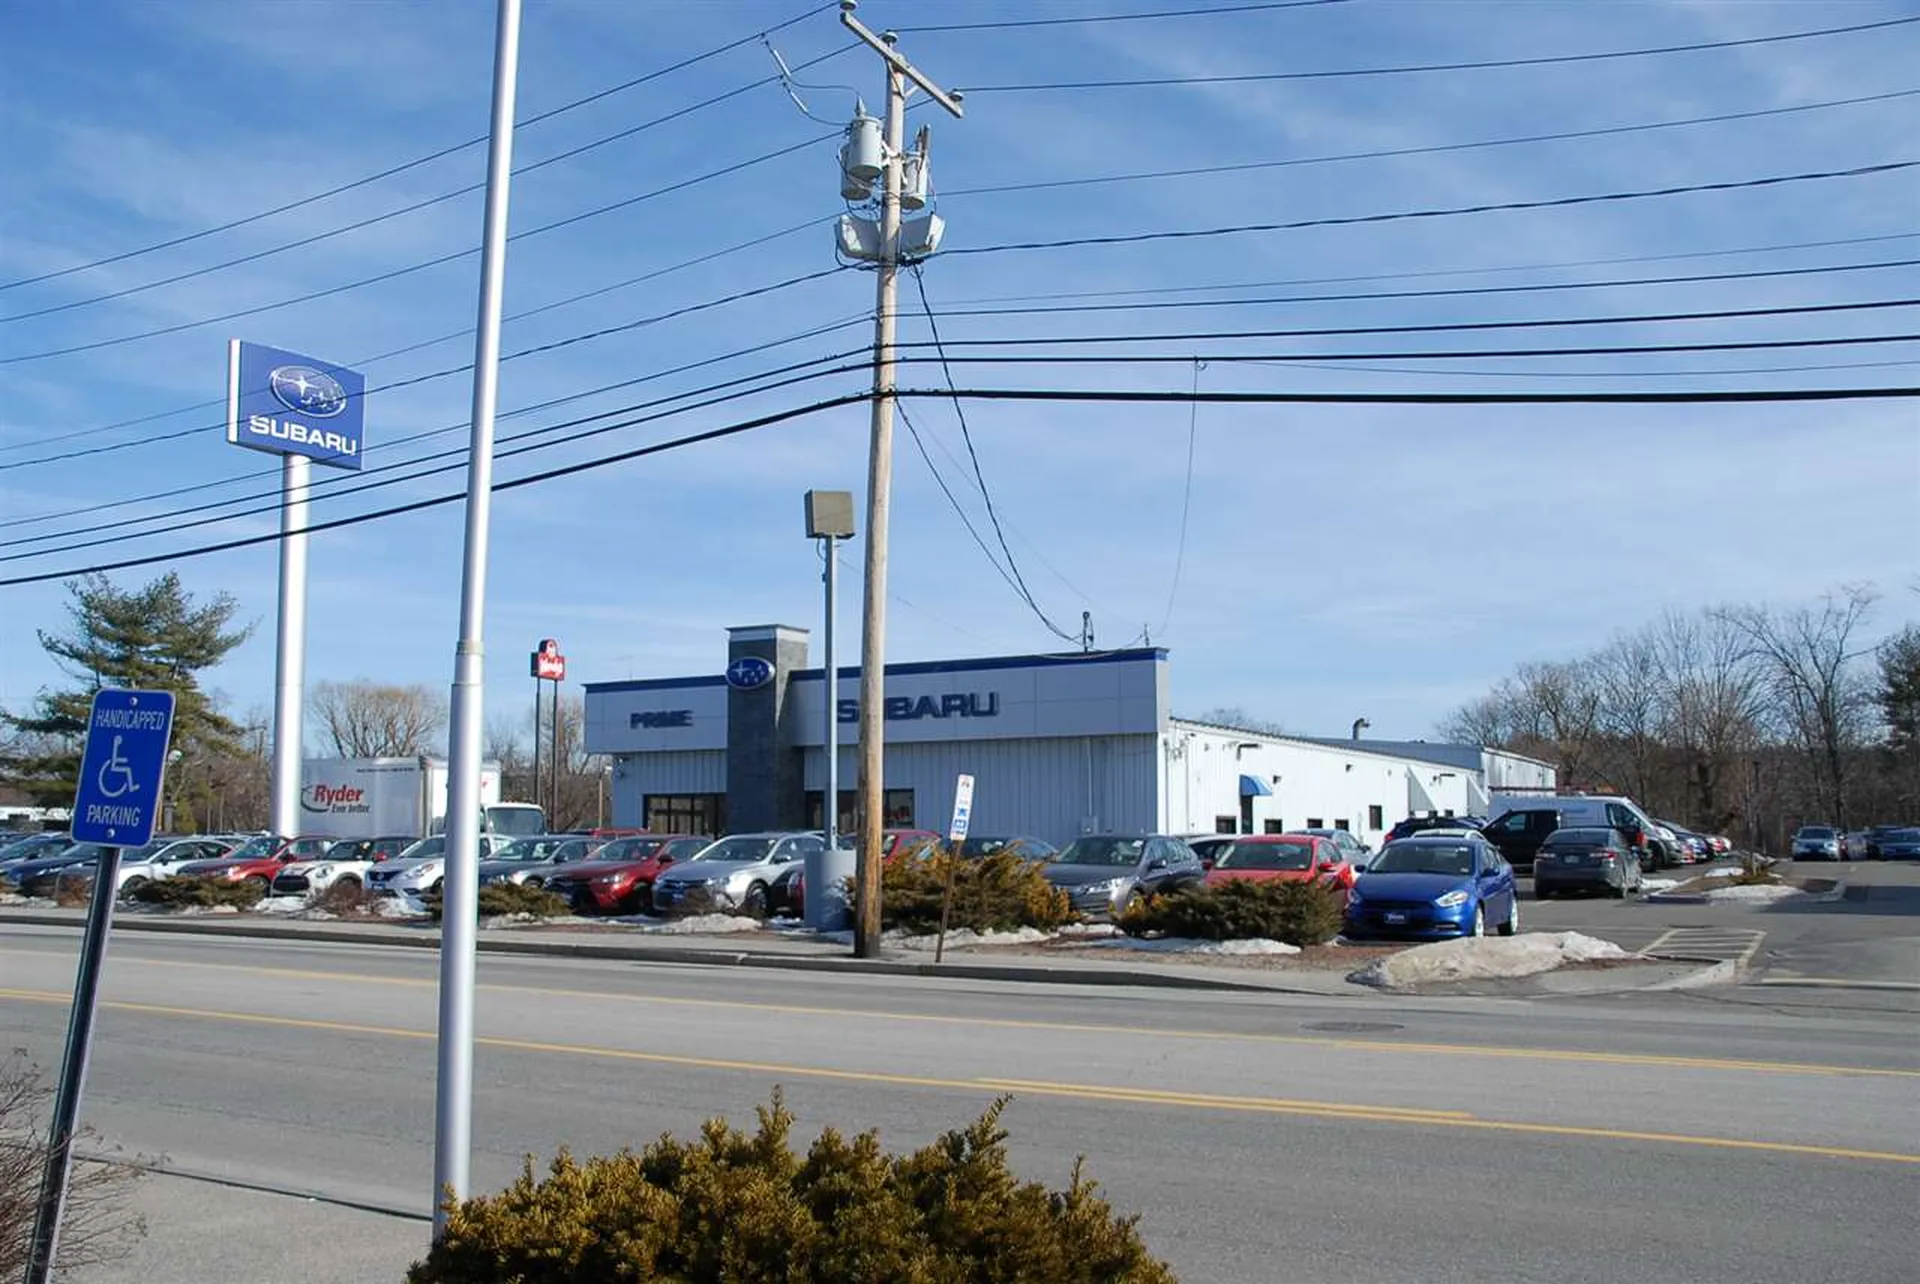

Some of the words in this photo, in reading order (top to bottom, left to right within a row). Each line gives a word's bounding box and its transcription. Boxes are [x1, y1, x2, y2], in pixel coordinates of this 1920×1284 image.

[250, 414, 356, 455] SUBARU
[836, 691, 999, 723] SBARU
[96, 708, 165, 730] HANDICAPPED
[630, 709, 694, 729] PRIME
[314, 784, 364, 807] Ryder
[86, 804, 141, 827] PARKING
